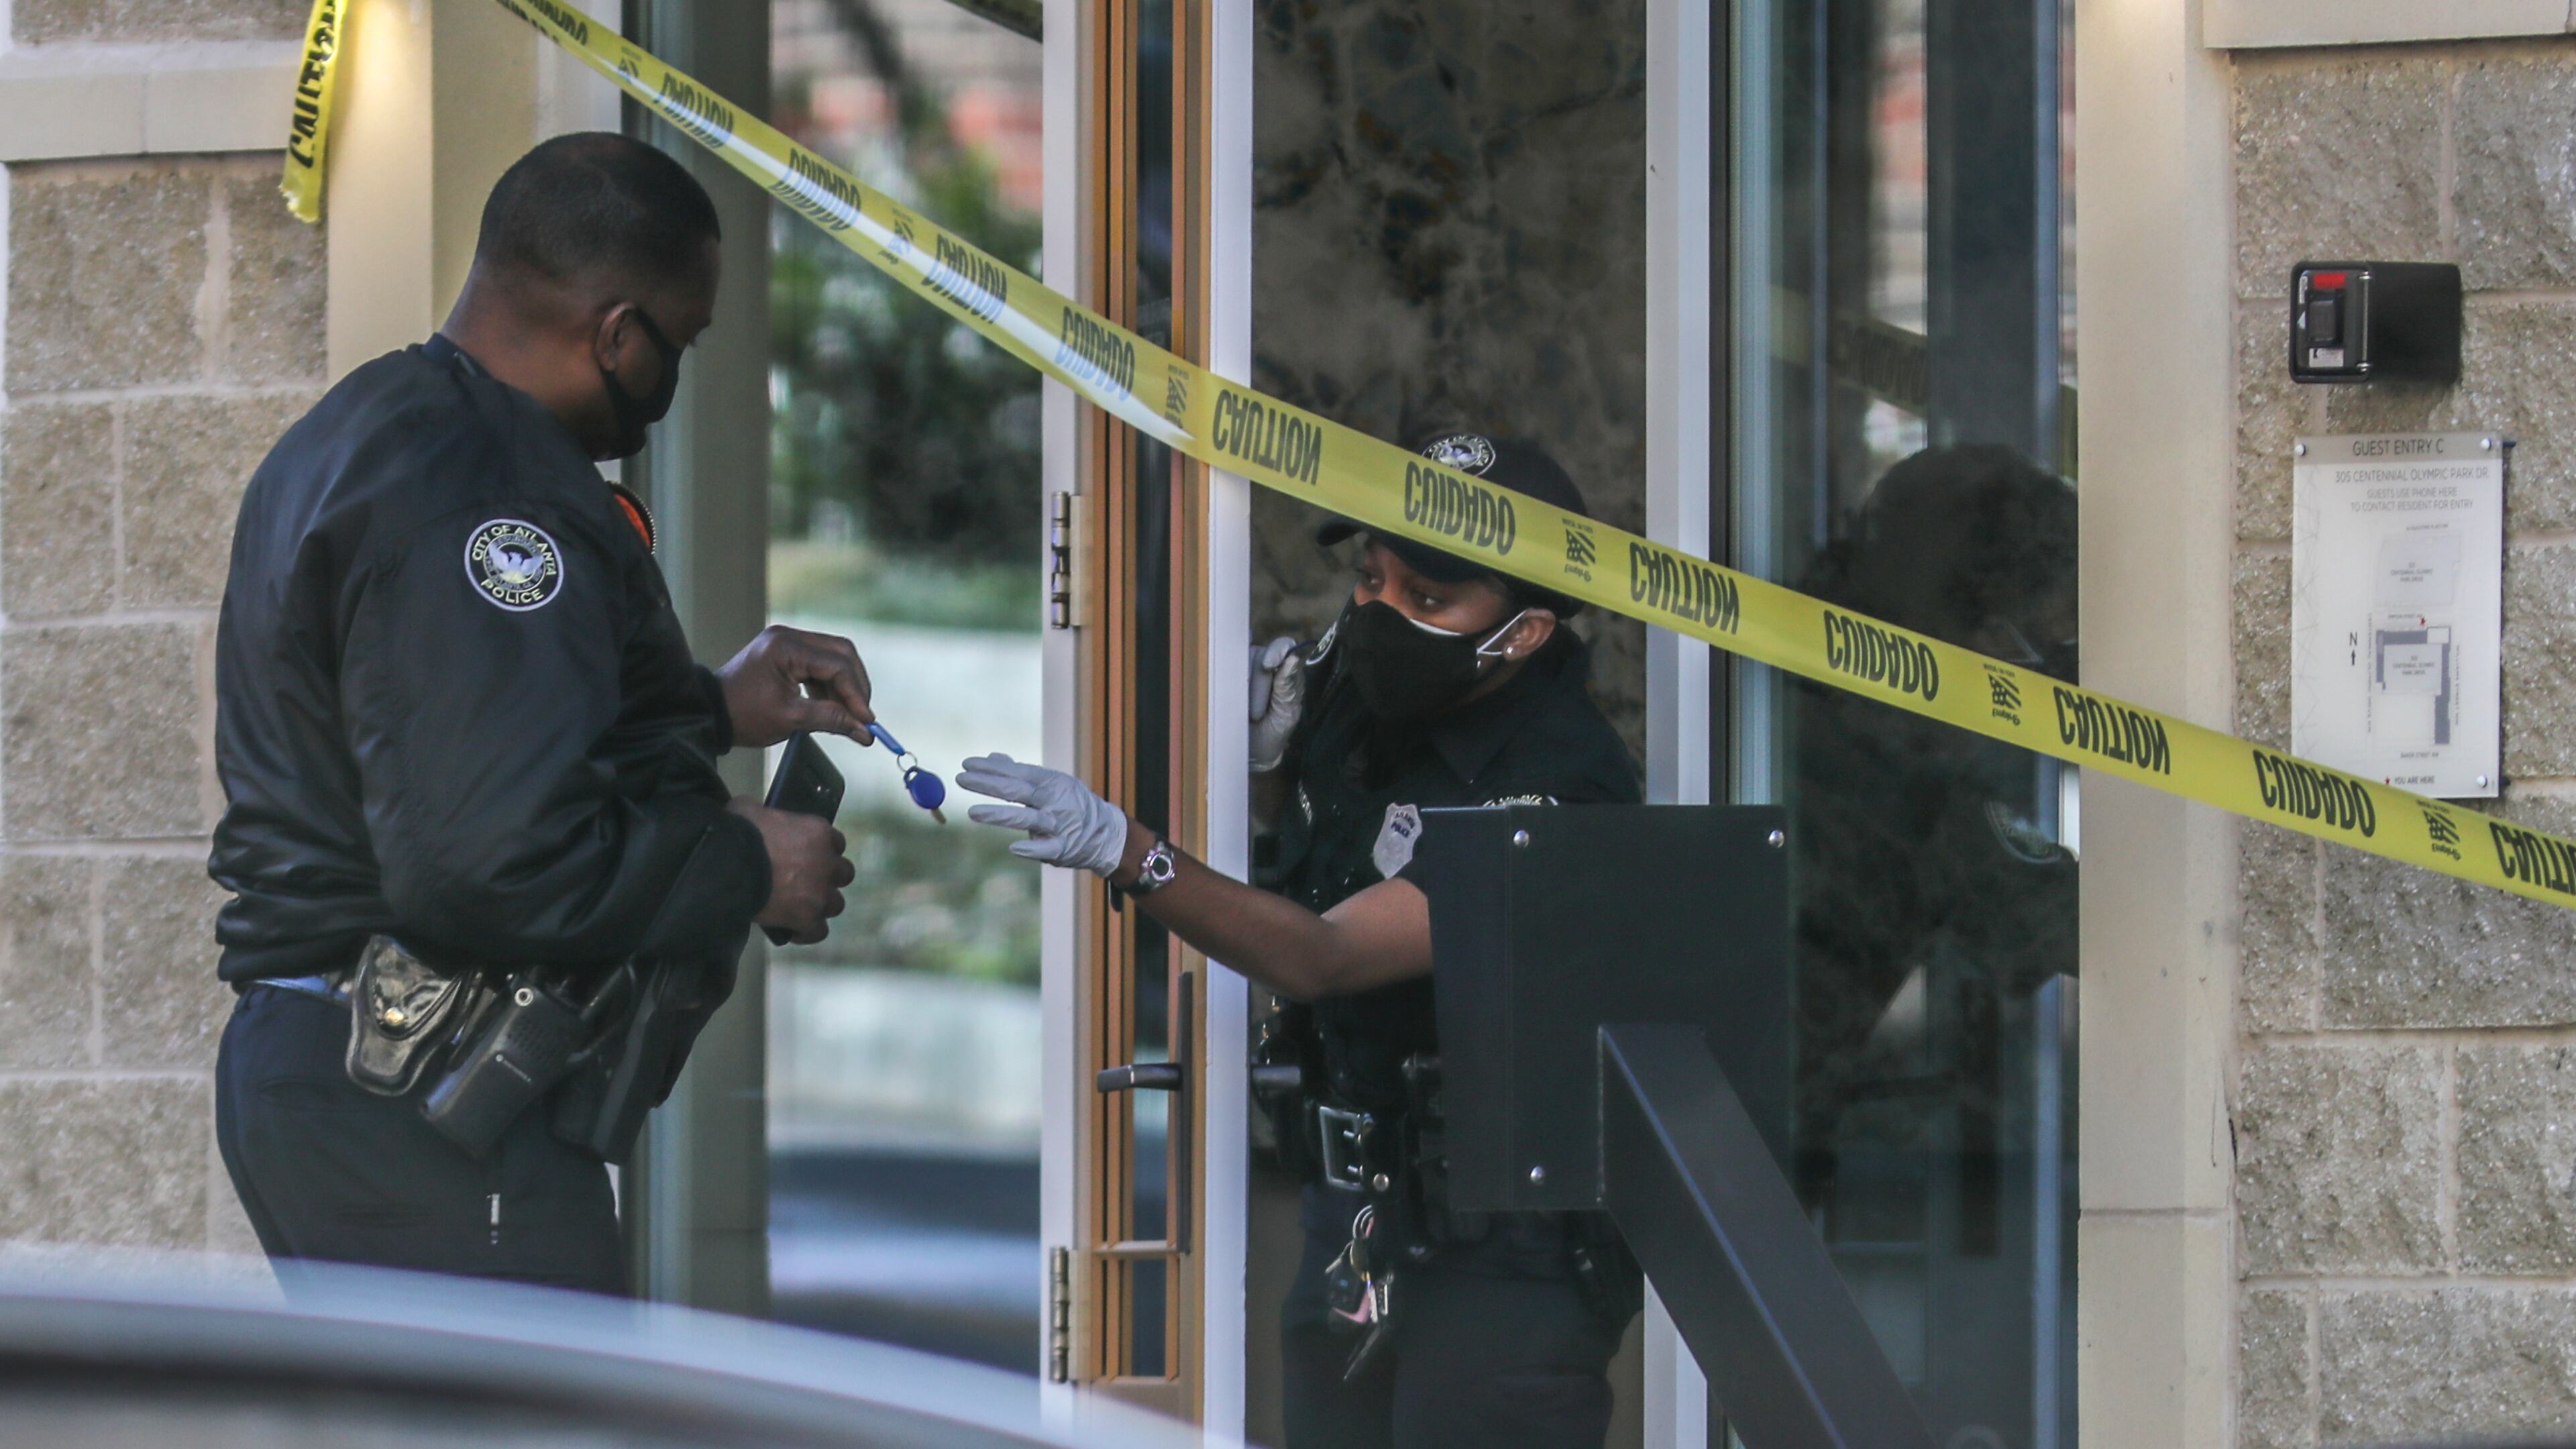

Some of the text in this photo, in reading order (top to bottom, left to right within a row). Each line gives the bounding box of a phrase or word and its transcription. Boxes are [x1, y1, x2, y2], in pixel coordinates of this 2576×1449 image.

[2353, 438, 2445, 456] GUEST ENTRY C
[2335, 471, 2351, 483] 305
[2353, 470, 2408, 482] CENTENNIAL
[2410, 468, 2448, 481] OLYMPIC
[2451, 468, 2474, 480] PARK
[472, 532, 492, 561] CITY
[490, 525, 511, 536] OF
[481, 578, 545, 604] POLICE
[2349, 632, 2357, 646] N
[2407, 776, 2418, 784] ARE
[2420, 775, 2435, 784] HERE
